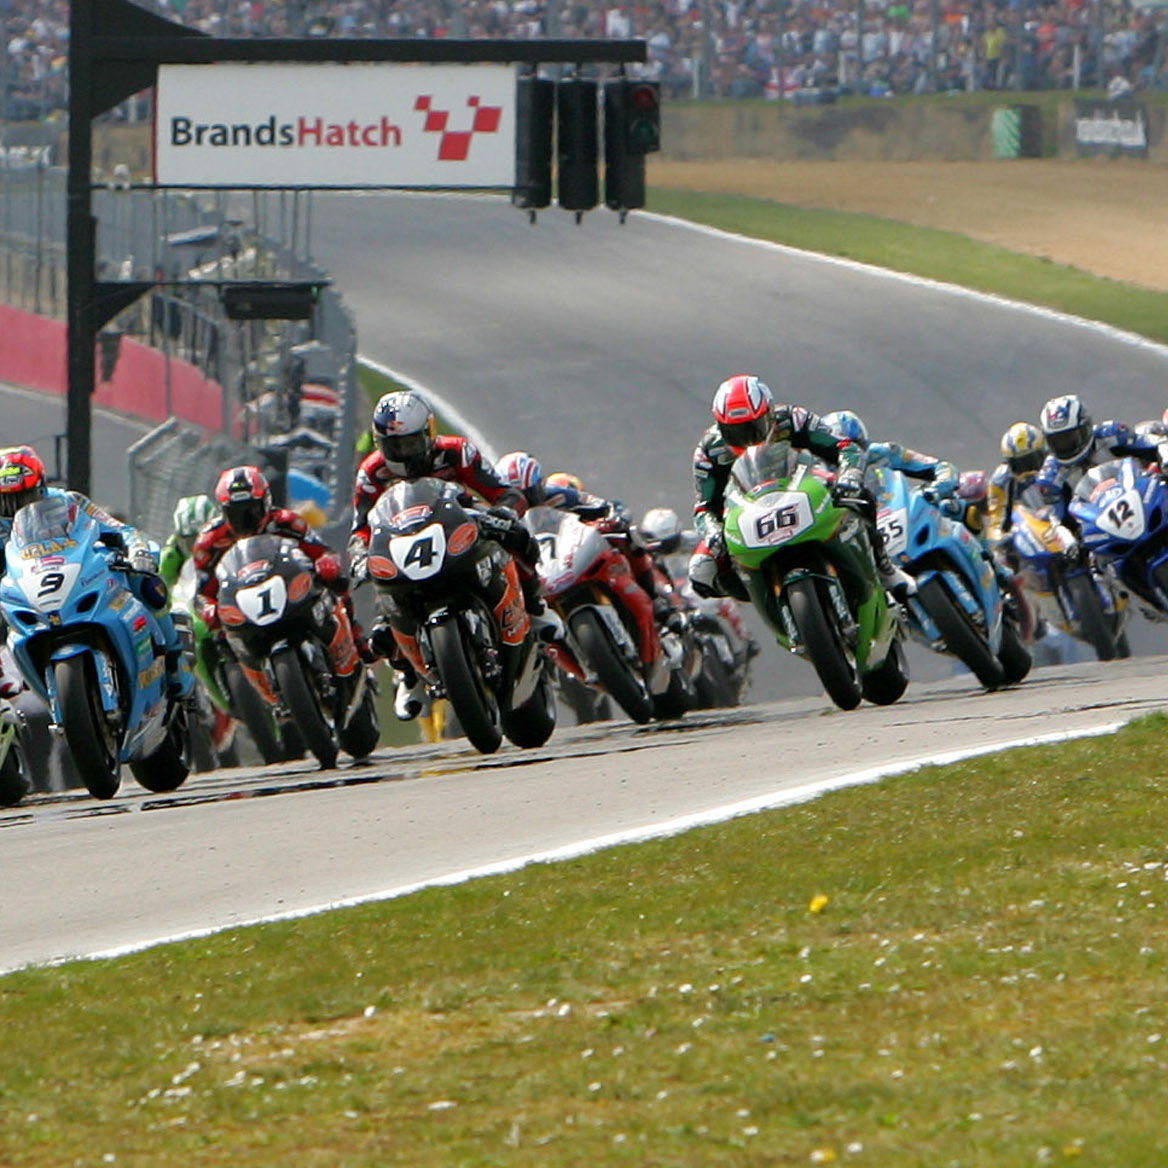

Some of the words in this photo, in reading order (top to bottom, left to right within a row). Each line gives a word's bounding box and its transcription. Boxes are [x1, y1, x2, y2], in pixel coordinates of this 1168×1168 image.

[170, 116, 403, 148] BrandsHatch
[757, 504, 798, 540] 66
[1108, 500, 1135, 529] 12
[403, 536, 438, 569] 4
[38, 573, 65, 598] 9
[256, 587, 280, 620] 1
